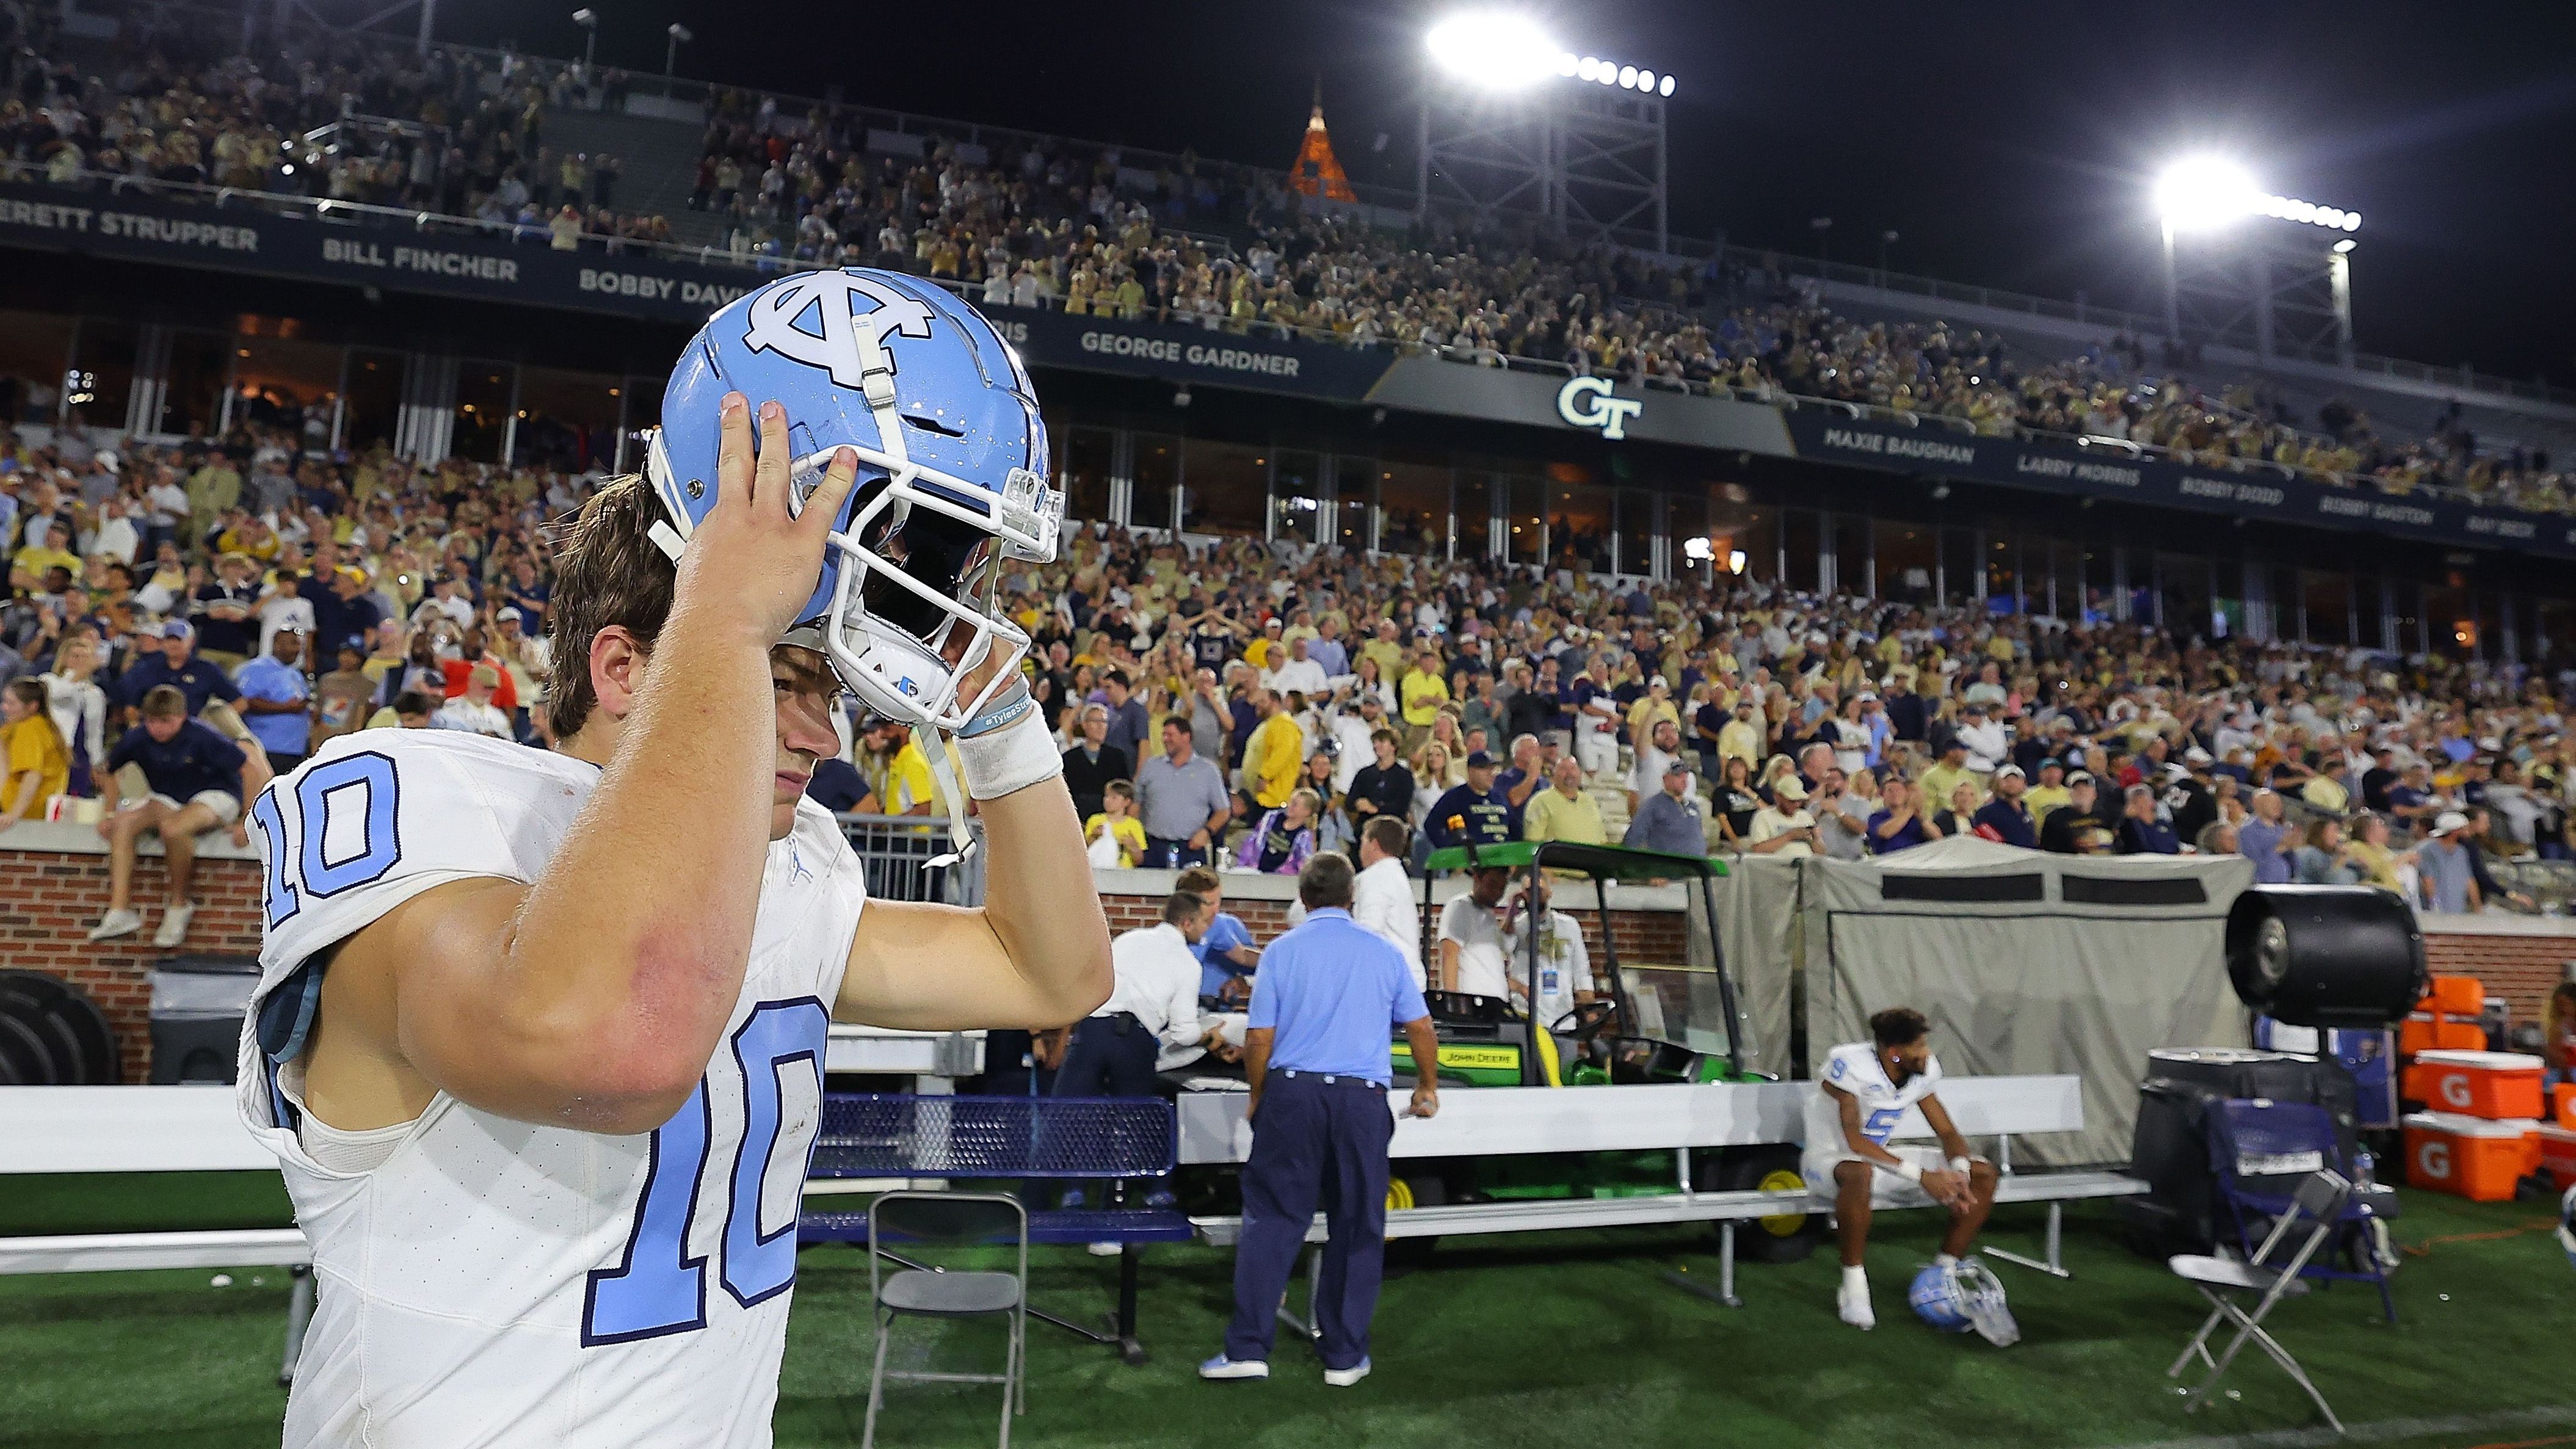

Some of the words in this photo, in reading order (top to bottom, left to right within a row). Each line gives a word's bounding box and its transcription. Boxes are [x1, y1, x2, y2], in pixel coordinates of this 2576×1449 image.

[99, 210, 258, 252] STRUPPER
[322, 238, 387, 267] BILL
[393, 246, 518, 282] FINCHER
[579, 268, 675, 299] BOBBY
[681, 281, 752, 305] DAV
[1080, 331, 1181, 361] GEORGE
[1186, 344, 1300, 377] GARDNER
[1558, 375, 1644, 441] GT
[1824, 429, 1884, 454] MAXIE
[1885, 437, 1975, 463] BAUGHAN
[2017, 454, 2075, 478] LARRY
[2077, 462, 2141, 486] MORRIS
[252, 750, 401, 932] 10
[2440, 1074, 2472, 1108] G
[581, 995, 830, 1348] 10
[2418, 1141, 2451, 1179] G
